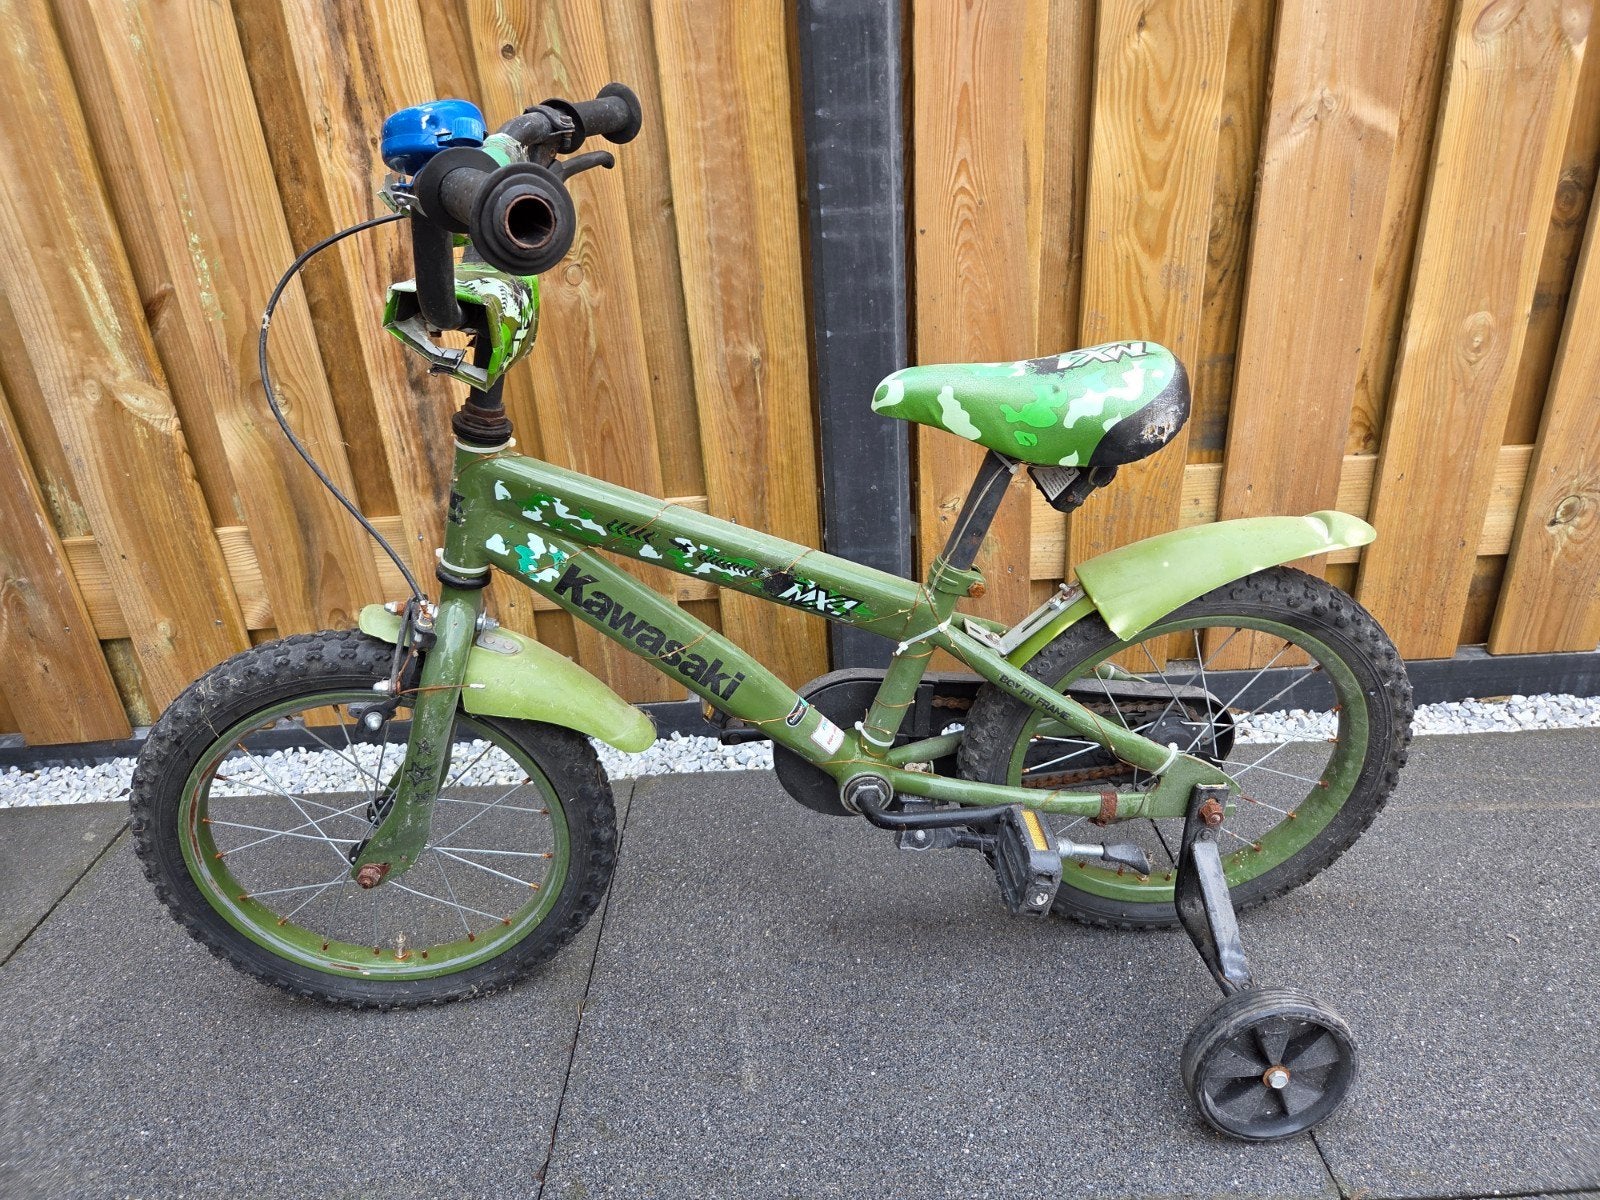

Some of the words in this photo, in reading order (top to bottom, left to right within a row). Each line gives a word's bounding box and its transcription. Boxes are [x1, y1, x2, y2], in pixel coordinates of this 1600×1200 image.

[777, 579, 863, 616] MX4
[553, 563, 745, 702] Kawasaki
[999, 674, 1021, 689] BOY
[1020, 689, 1036, 700] FIT
[1037, 697, 1071, 720] FRAME
